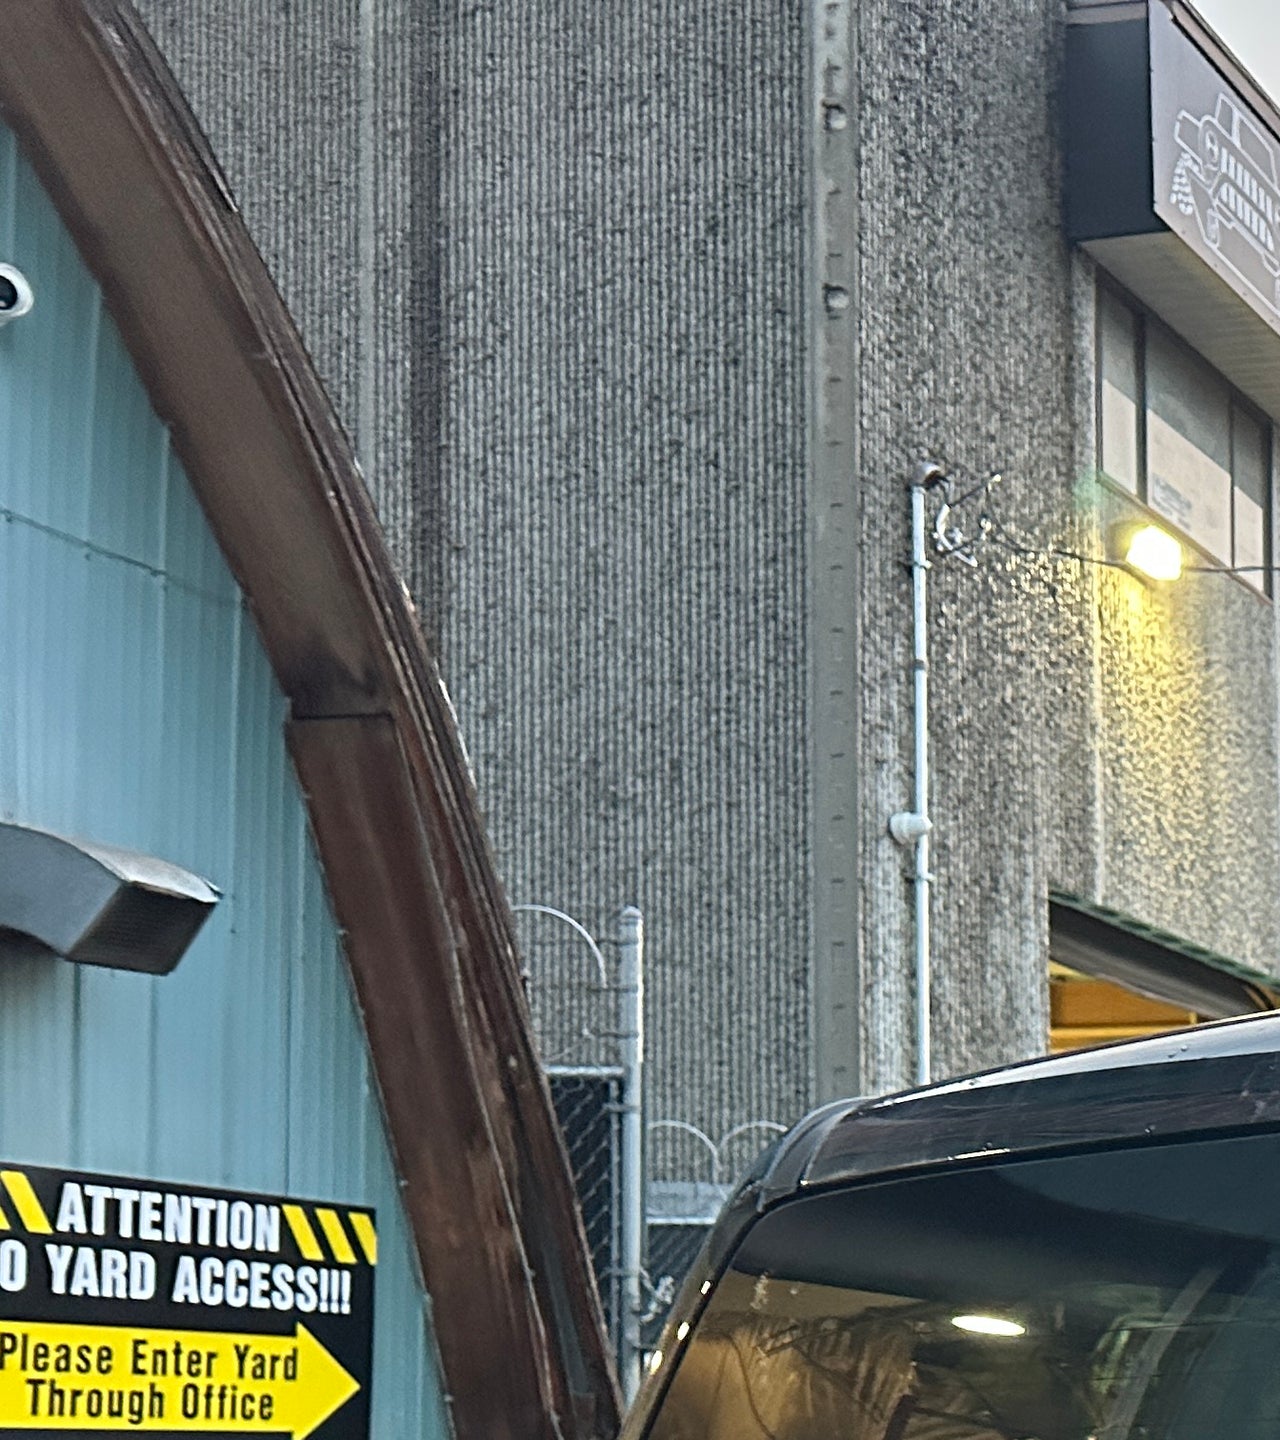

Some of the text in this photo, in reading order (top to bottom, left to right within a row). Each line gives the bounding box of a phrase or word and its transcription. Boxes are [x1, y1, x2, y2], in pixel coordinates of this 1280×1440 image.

[56, 1182, 280, 1252] ATTENTION
[46, 1244, 156, 1301] YARD
[172, 1255, 351, 1315] ACCESS!!!
[0, 1332, 298, 1381] Please Enter Yard
[25, 1378, 274, 1425] Through Office
